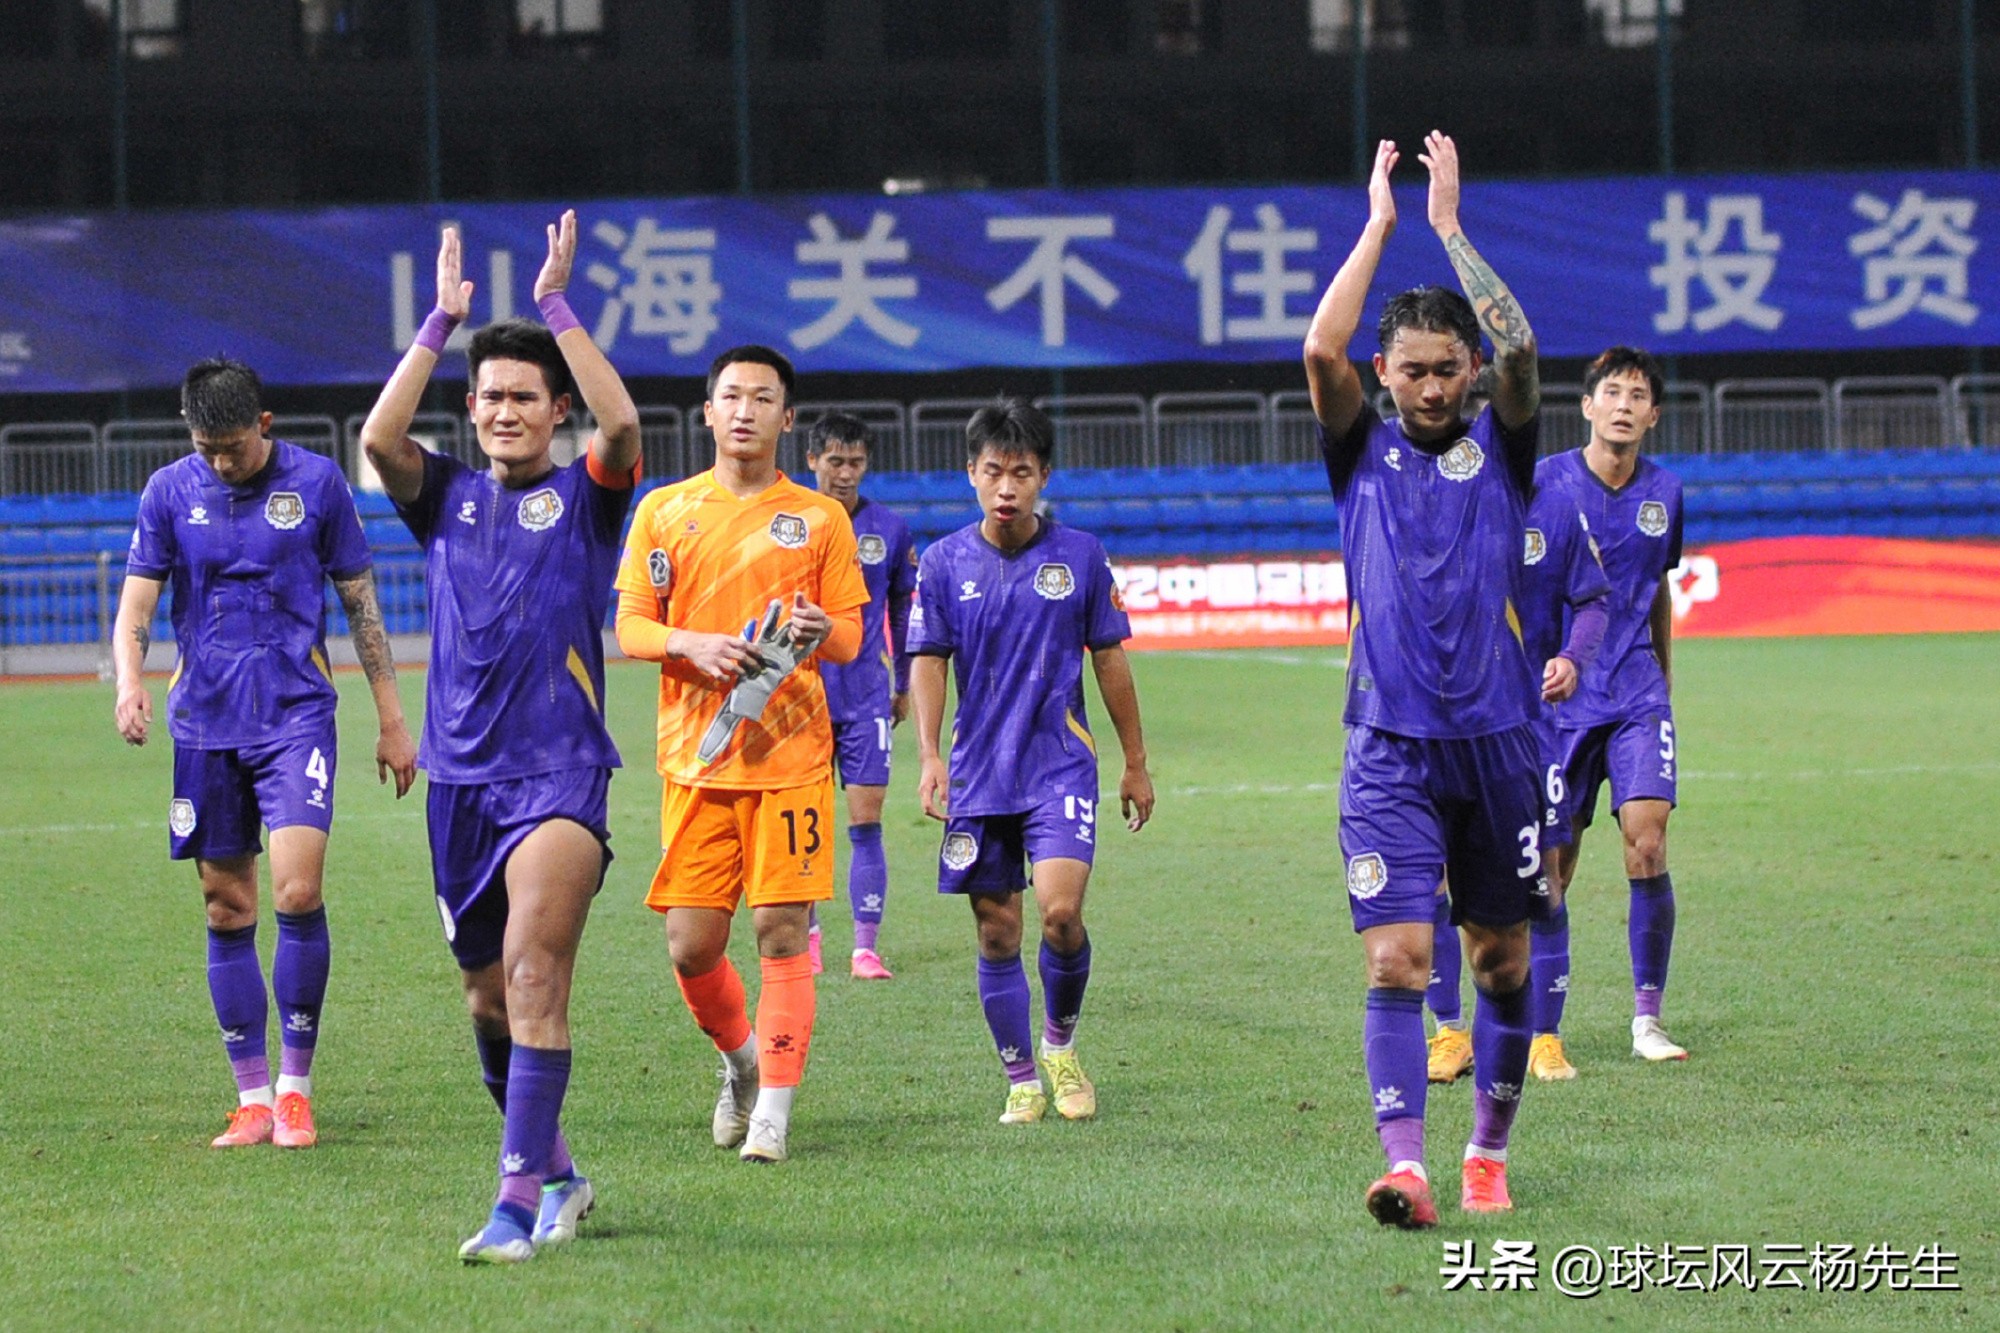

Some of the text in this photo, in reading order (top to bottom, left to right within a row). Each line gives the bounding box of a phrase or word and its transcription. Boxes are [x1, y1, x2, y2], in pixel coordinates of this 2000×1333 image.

[391, 190, 1978, 356] 山海关不住 投资
[1659, 720, 1674, 761] 5
[305, 747, 328, 789] 4
[1546, 763, 1564, 804] 6
[780, 807, 821, 856] 13
